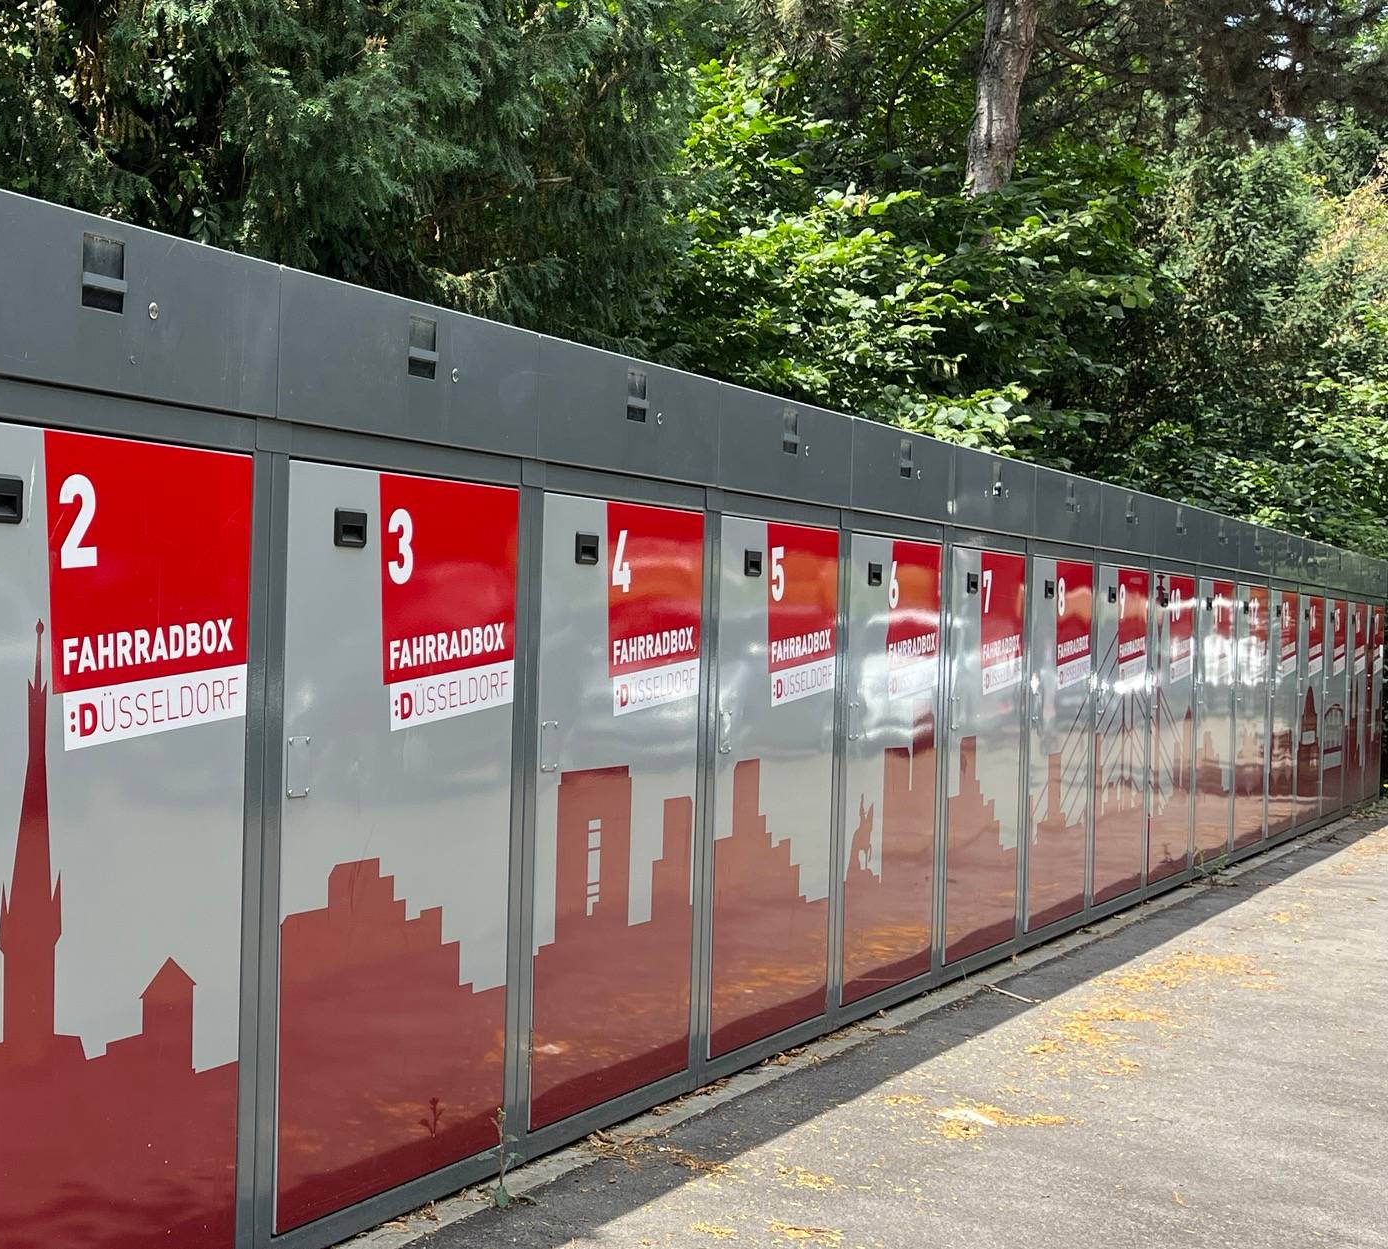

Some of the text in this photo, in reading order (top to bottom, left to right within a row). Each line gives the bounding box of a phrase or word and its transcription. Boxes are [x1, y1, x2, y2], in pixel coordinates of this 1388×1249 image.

[59, 474, 98, 569] 2
[388, 508, 413, 585] 3
[612, 530, 631, 593] 4
[771, 546, 785, 602] 5
[888, 561, 899, 609] 6
[983, 570, 992, 614] 7
[1058, 577, 1065, 617] 8
[1119, 583, 1126, 619] 9
[1171, 588, 1181, 622] 10
[63, 618, 233, 675] FAHRRADBOX
[389, 623, 505, 671] FAHRRADBOX
[613, 626, 694, 665] FAHRRADBOX
[771, 629, 831, 663] FAHRRADBOX
[888, 632, 936, 663] FAHRRADBOX
